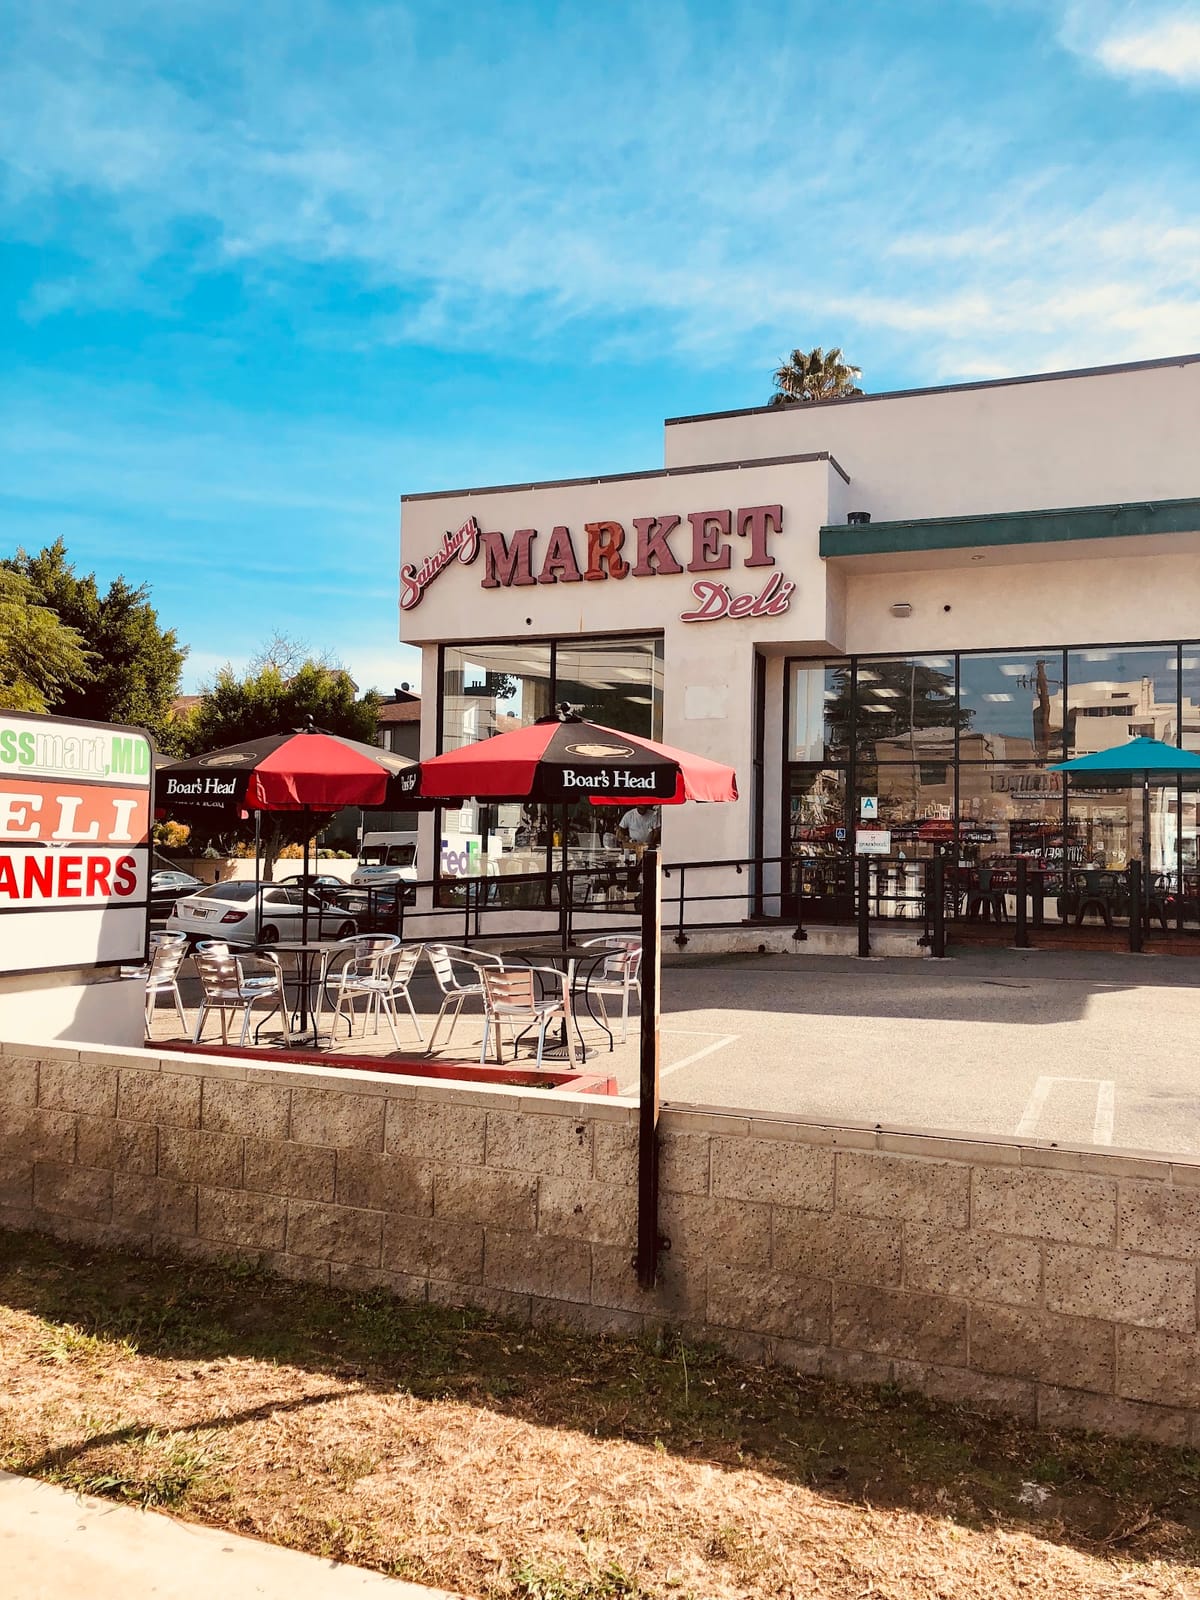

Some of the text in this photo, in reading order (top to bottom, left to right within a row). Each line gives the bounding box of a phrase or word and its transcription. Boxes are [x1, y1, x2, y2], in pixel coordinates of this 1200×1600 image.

[399, 515, 480, 610] Sainsbury
[480, 504, 783, 588] MARKET
[680, 571, 795, 622] Deli
[166, 777, 237, 795] Boar's Head
[562, 769, 657, 790] Boar's Head
[0, 793, 138, 841] ELI
[863, 798, 874, 809] A
[0, 855, 137, 900] ANERS
